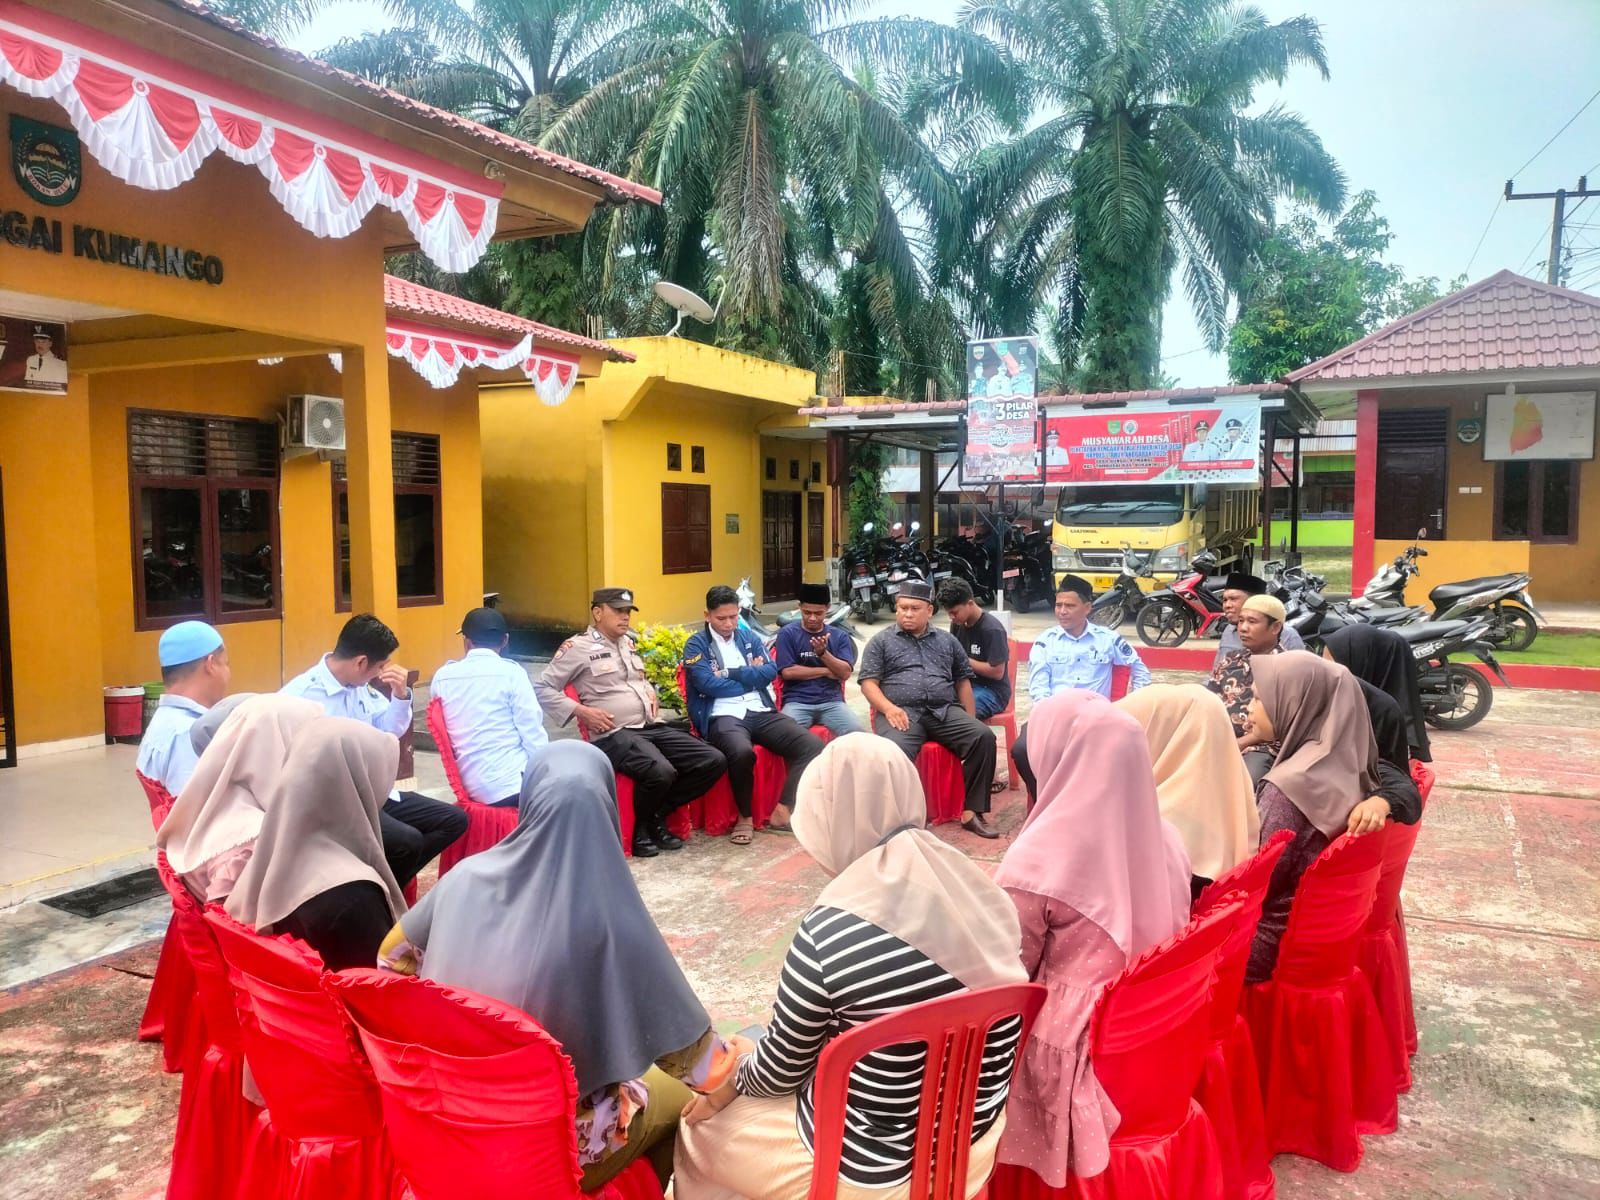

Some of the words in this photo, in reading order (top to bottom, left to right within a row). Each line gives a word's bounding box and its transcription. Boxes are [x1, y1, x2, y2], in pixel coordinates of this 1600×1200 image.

[0, 209, 62, 254] GAI
[73, 224, 224, 285] KUMANGO
[995, 403, 1005, 421] 3
[1006, 401, 1034, 411] PILAR
[1006, 411, 1030, 420] DESA
[1082, 435, 1145, 446] MUSYAWARAH
[1146, 434, 1169, 444] DESA
